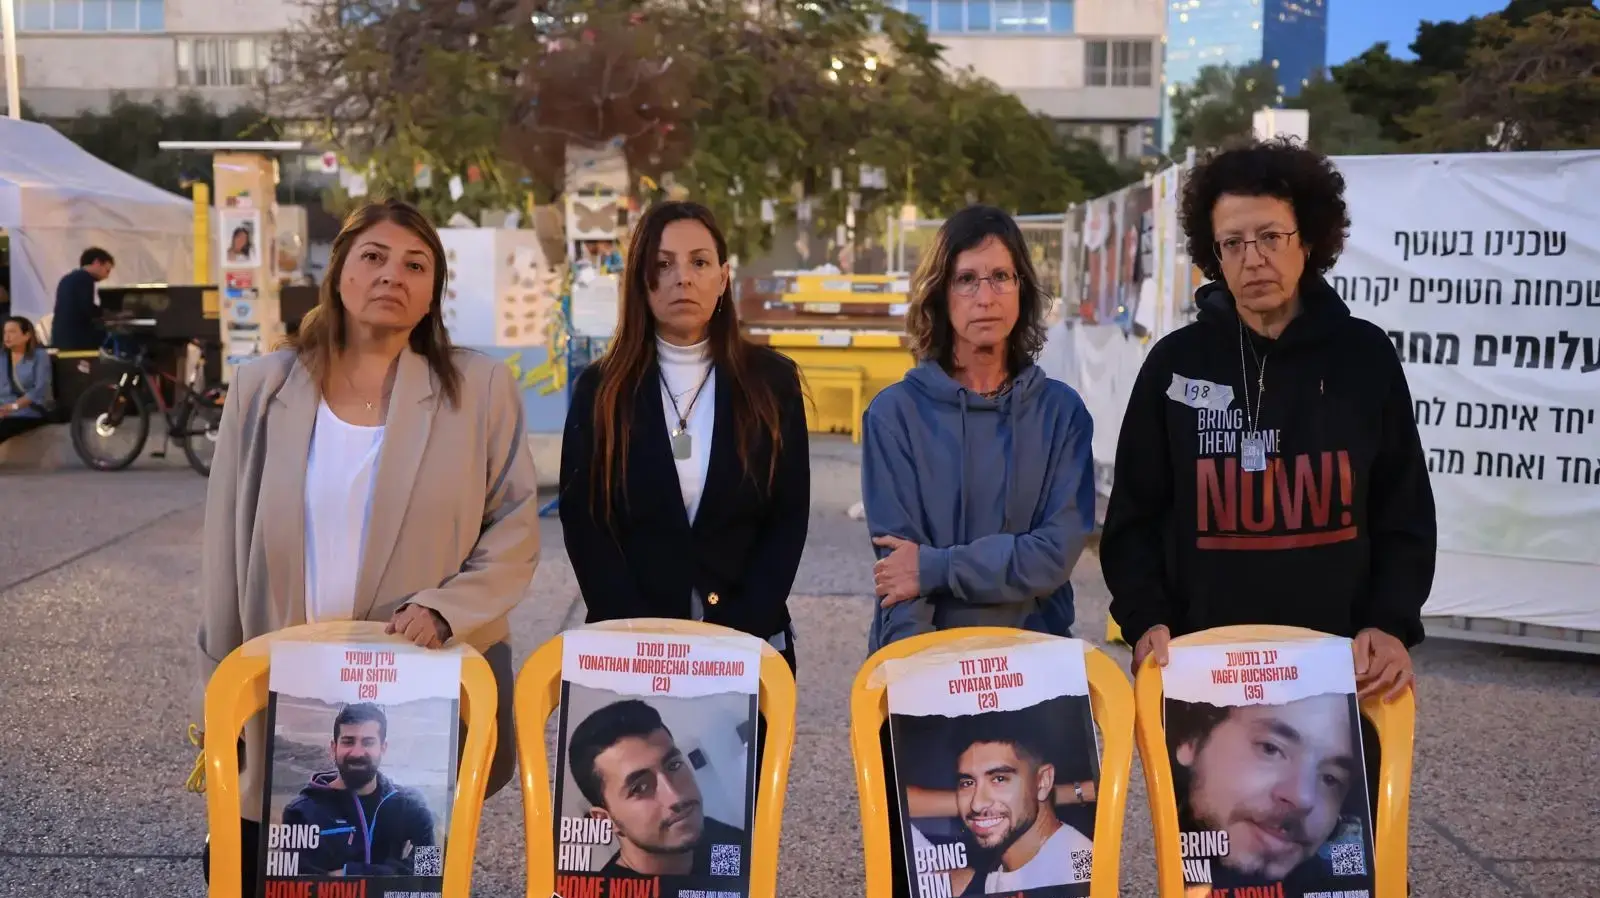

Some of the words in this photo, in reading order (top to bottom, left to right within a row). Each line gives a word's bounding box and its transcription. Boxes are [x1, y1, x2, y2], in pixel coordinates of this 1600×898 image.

[1394, 230, 1473, 261] בעוטף
[1484, 230, 1567, 257] שכנינו
[1332, 276, 1399, 307] יקרות
[1409, 277, 1502, 304] חטופים
[1511, 279, 1600, 307] שפחות
[1184, 383, 1211, 400] 198
[1197, 408, 1243, 431] BRING
[1456, 401, 1538, 431] איתכם
[1549, 406, 1594, 434] יחד
[1197, 430, 1236, 454] THEM
[1474, 451, 1545, 480] ואחת
[1196, 449, 1353, 532] NOW!
[340, 668, 363, 682] IDAN
[366, 668, 398, 682] SHTIVI
[578, 654, 630, 673] YONATHAN
[632, 658, 690, 676] MORDECHAI
[692, 660, 745, 677] SAMERANO
[958, 659, 976, 676] דוד
[977, 656, 1008, 674] אביתר
[1211, 669, 1239, 684] YAGEV
[1240, 666, 1298, 683] BUCHSHTAB
[358, 683, 378, 700] (28)
[652, 675, 671, 692] (21)
[948, 676, 992, 695] EVYATAR
[993, 672, 1024, 690] DAVID
[1244, 683, 1264, 700] (35)
[978, 691, 999, 710] (23)
[268, 823, 320, 849] BRING
[560, 816, 612, 845] BRING
[1180, 830, 1230, 857] BRING
[266, 851, 299, 876] HIM
[558, 844, 592, 872] HIM
[915, 842, 968, 873] BRING
[1182, 859, 1212, 884] HIM
[265, 880, 313, 898] HOME
[556, 875, 605, 898] HOME
[609, 875, 660, 898] NOW!
[918, 871, 952, 898] HIM
